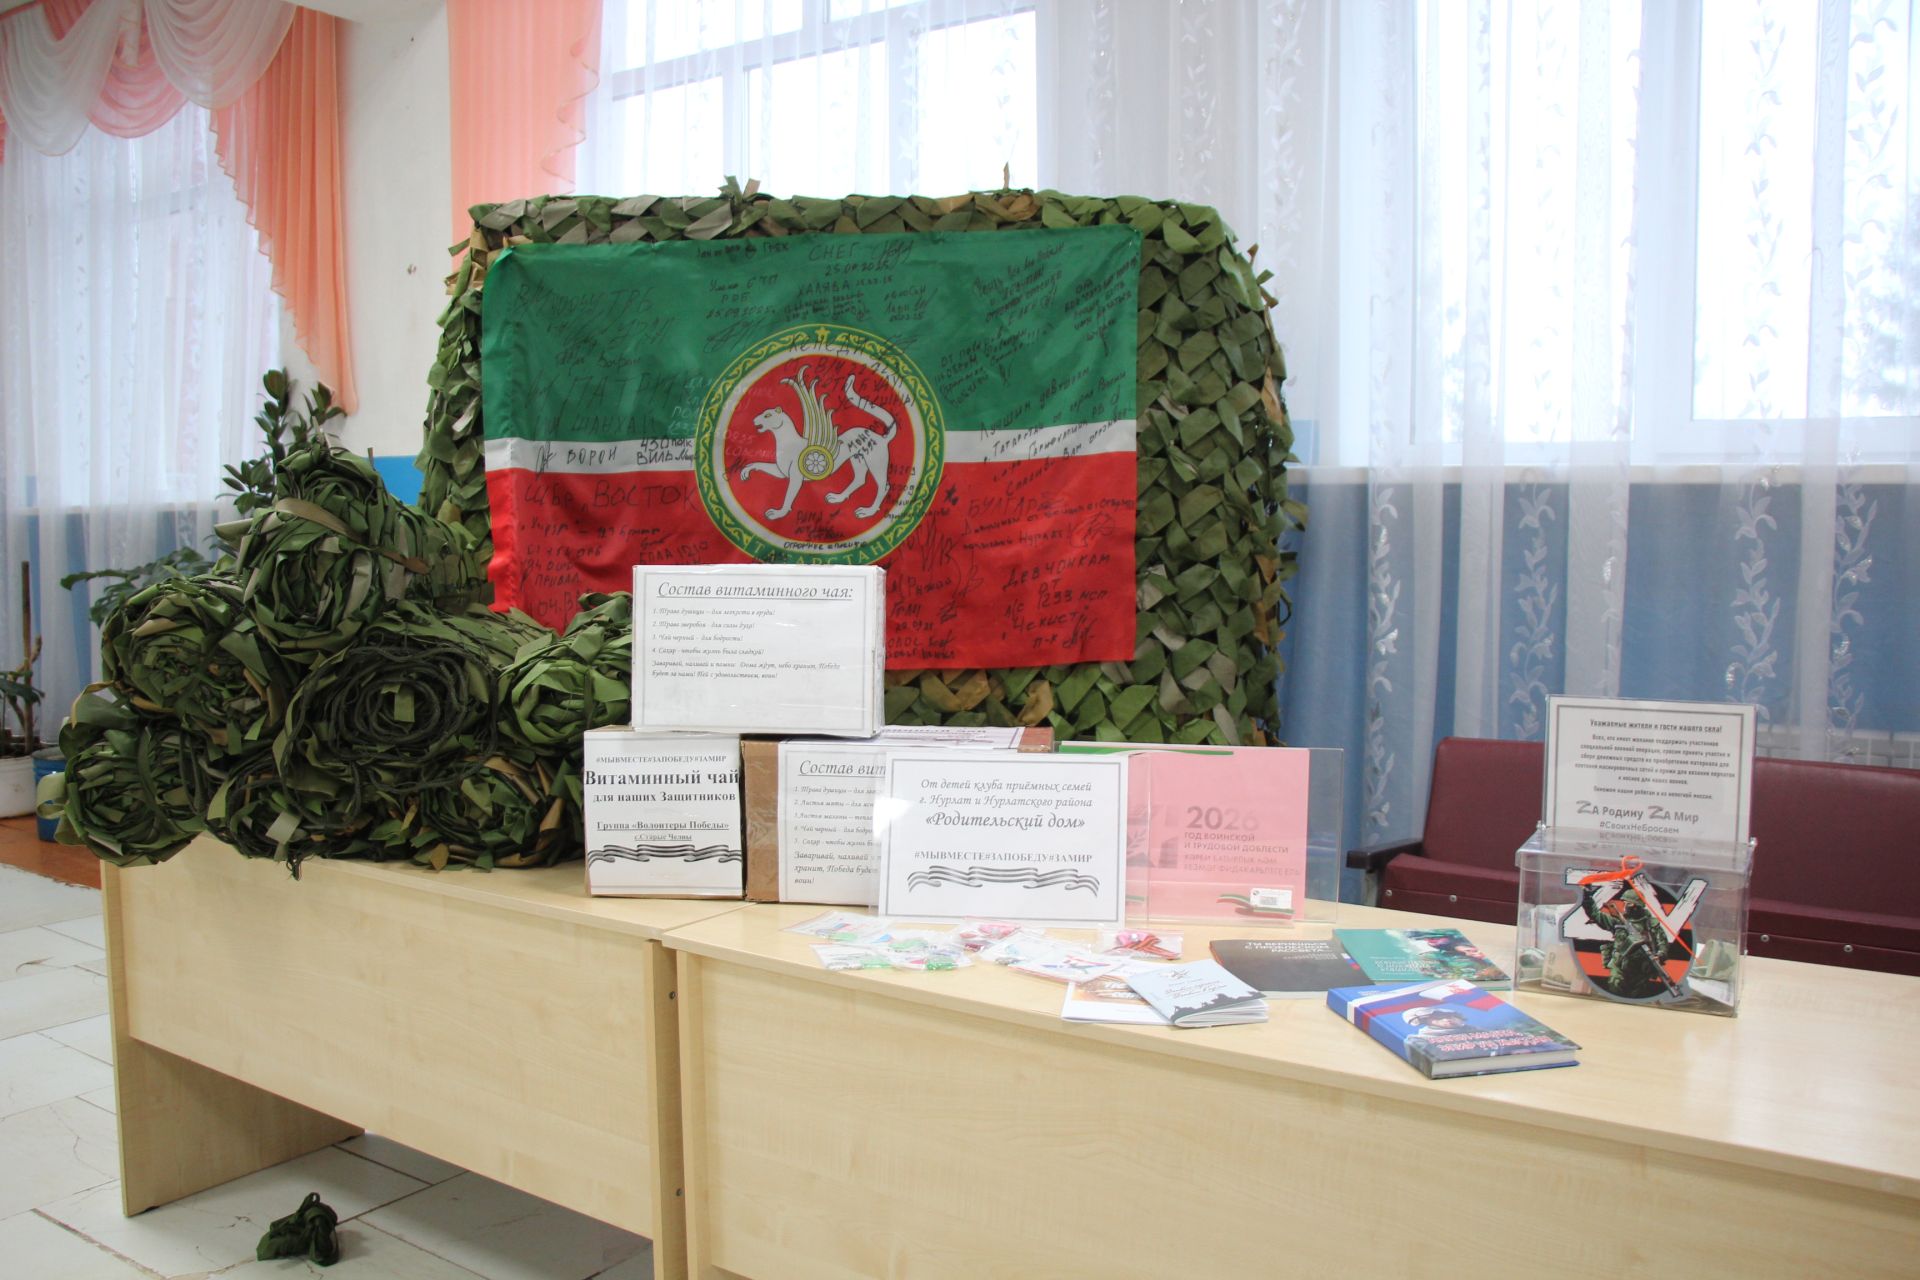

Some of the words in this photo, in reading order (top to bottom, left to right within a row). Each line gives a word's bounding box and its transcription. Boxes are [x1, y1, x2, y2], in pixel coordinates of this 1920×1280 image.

[566, 447, 617, 465] ВОРОН
[593, 479, 703, 513] ВОСТОК
[658, 581, 712, 597] Состав
[715, 585, 818, 598] витаминного
[822, 588, 854, 599] чая:
[1590, 719, 1627, 728] Уважаемые
[800, 760, 853, 775] Состав
[585, 769, 701, 785] Витаминный
[707, 769, 740, 785] чай
[921, 779, 938, 789] От
[940, 778, 971, 790] детей
[974, 778, 1003, 792] клуба
[1005, 781, 1060, 793] приёмных
[1062, 782, 1092, 792] семей
[593, 793, 614, 803] для
[617, 793, 656, 802] наших
[660, 791, 736, 802] Защитников
[930, 795, 971, 808] Нурлат
[983, 795, 1053, 810] Нурлатского
[1055, 797, 1093, 810] района
[926, 811, 1043, 831] «Родительский
[1047, 811, 1086, 829] дом»
[1186, 805, 1260, 831] 2026
[1602, 805, 1644, 821] Родину
[1674, 811, 1700, 824] Мир
[597, 821, 630, 832] Группа
[631, 820, 687, 831] «Волонтеры
[689, 820, 729, 831] Победы»
[1599, 820, 1680, 834] #СвоихНеБросаем
[1184, 831, 1202, 841] ГОД
[1203, 832, 1255, 842] ВОИНСКОЙ
[794, 851, 835, 862] Заваривай,
[914, 850, 1093, 863] #МЫВМЕСТЕ#ЗАПОБЕДУ#ЗАМИР
[1242, 844, 1289, 854] ДОБЛЕСТИ
[794, 866, 825, 875] хранит,
[827, 865, 854, 874] Победа
